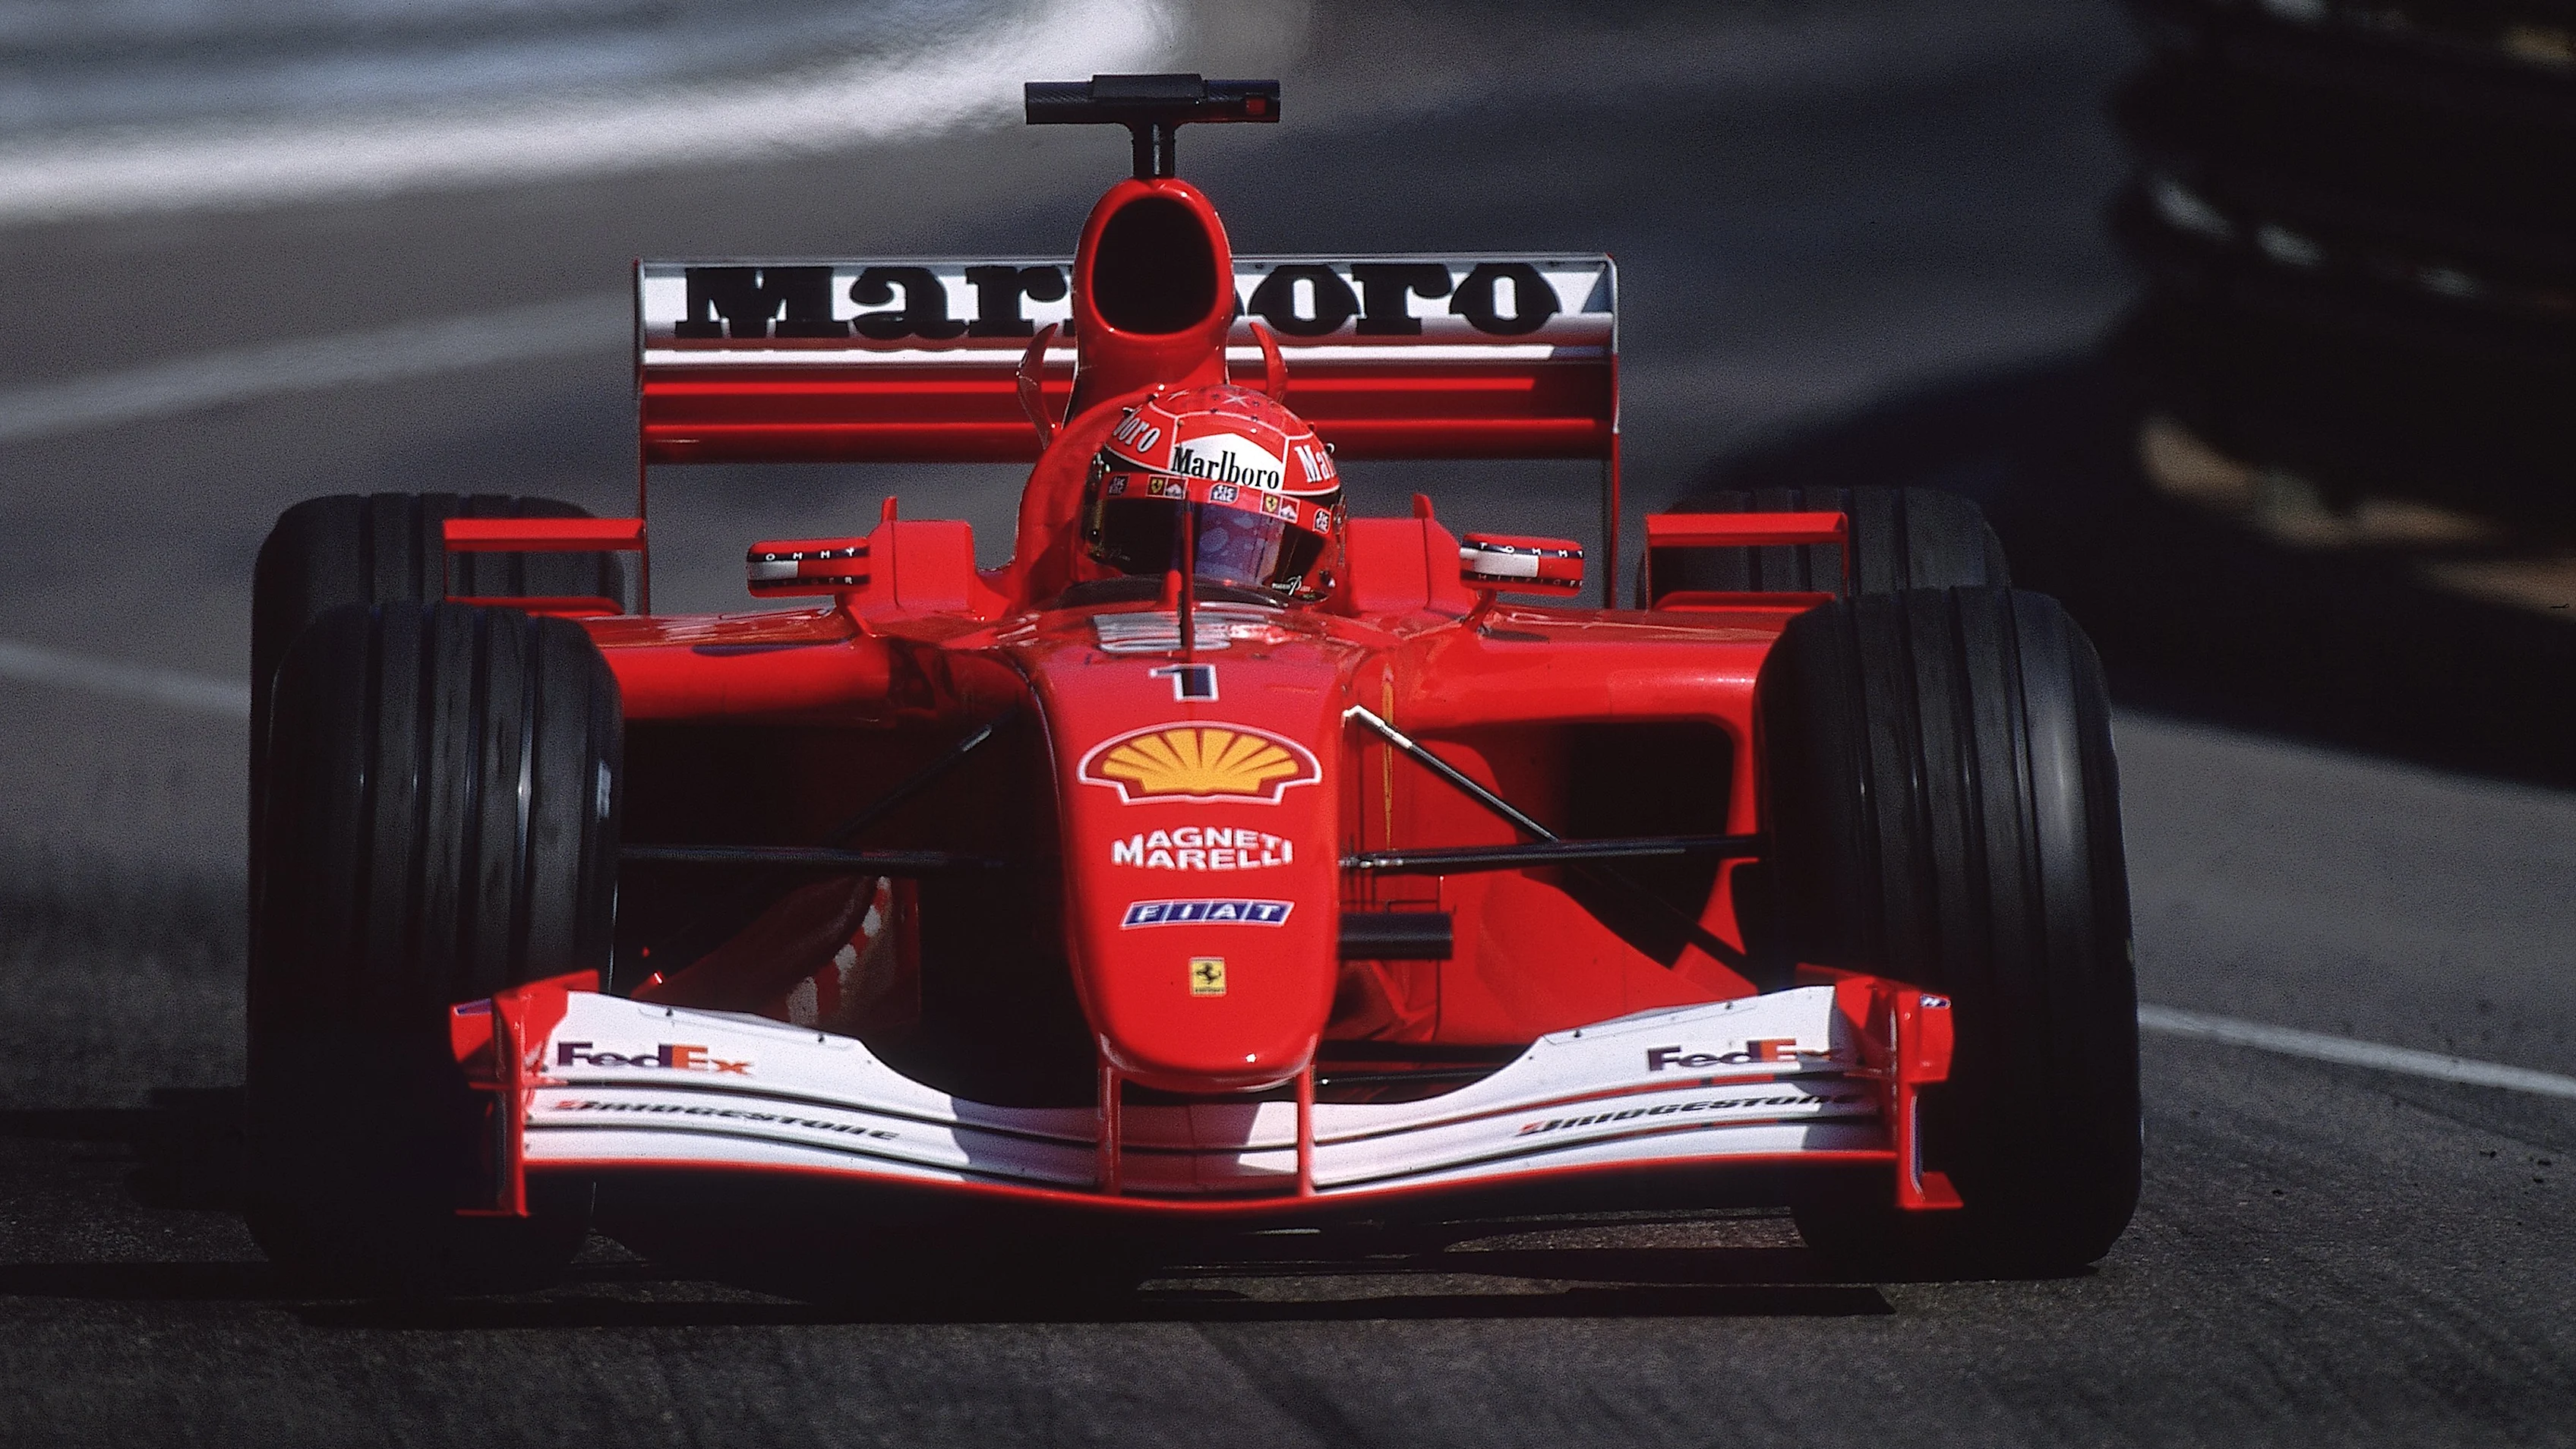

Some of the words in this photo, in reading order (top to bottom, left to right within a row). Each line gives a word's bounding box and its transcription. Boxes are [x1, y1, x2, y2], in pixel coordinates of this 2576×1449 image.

[674, 264, 1560, 339] Maroro
[1172, 445, 1280, 490] Marlboro
[1148, 663, 1219, 702] 1
[1112, 826, 1293, 864] MAGNETI
[1112, 835, 1293, 871] MARELLI
[1135, 901, 1283, 923] FIAT
[557, 1040, 755, 1077] FedEx
[552, 1098, 901, 1141] BRIDGESTONE
